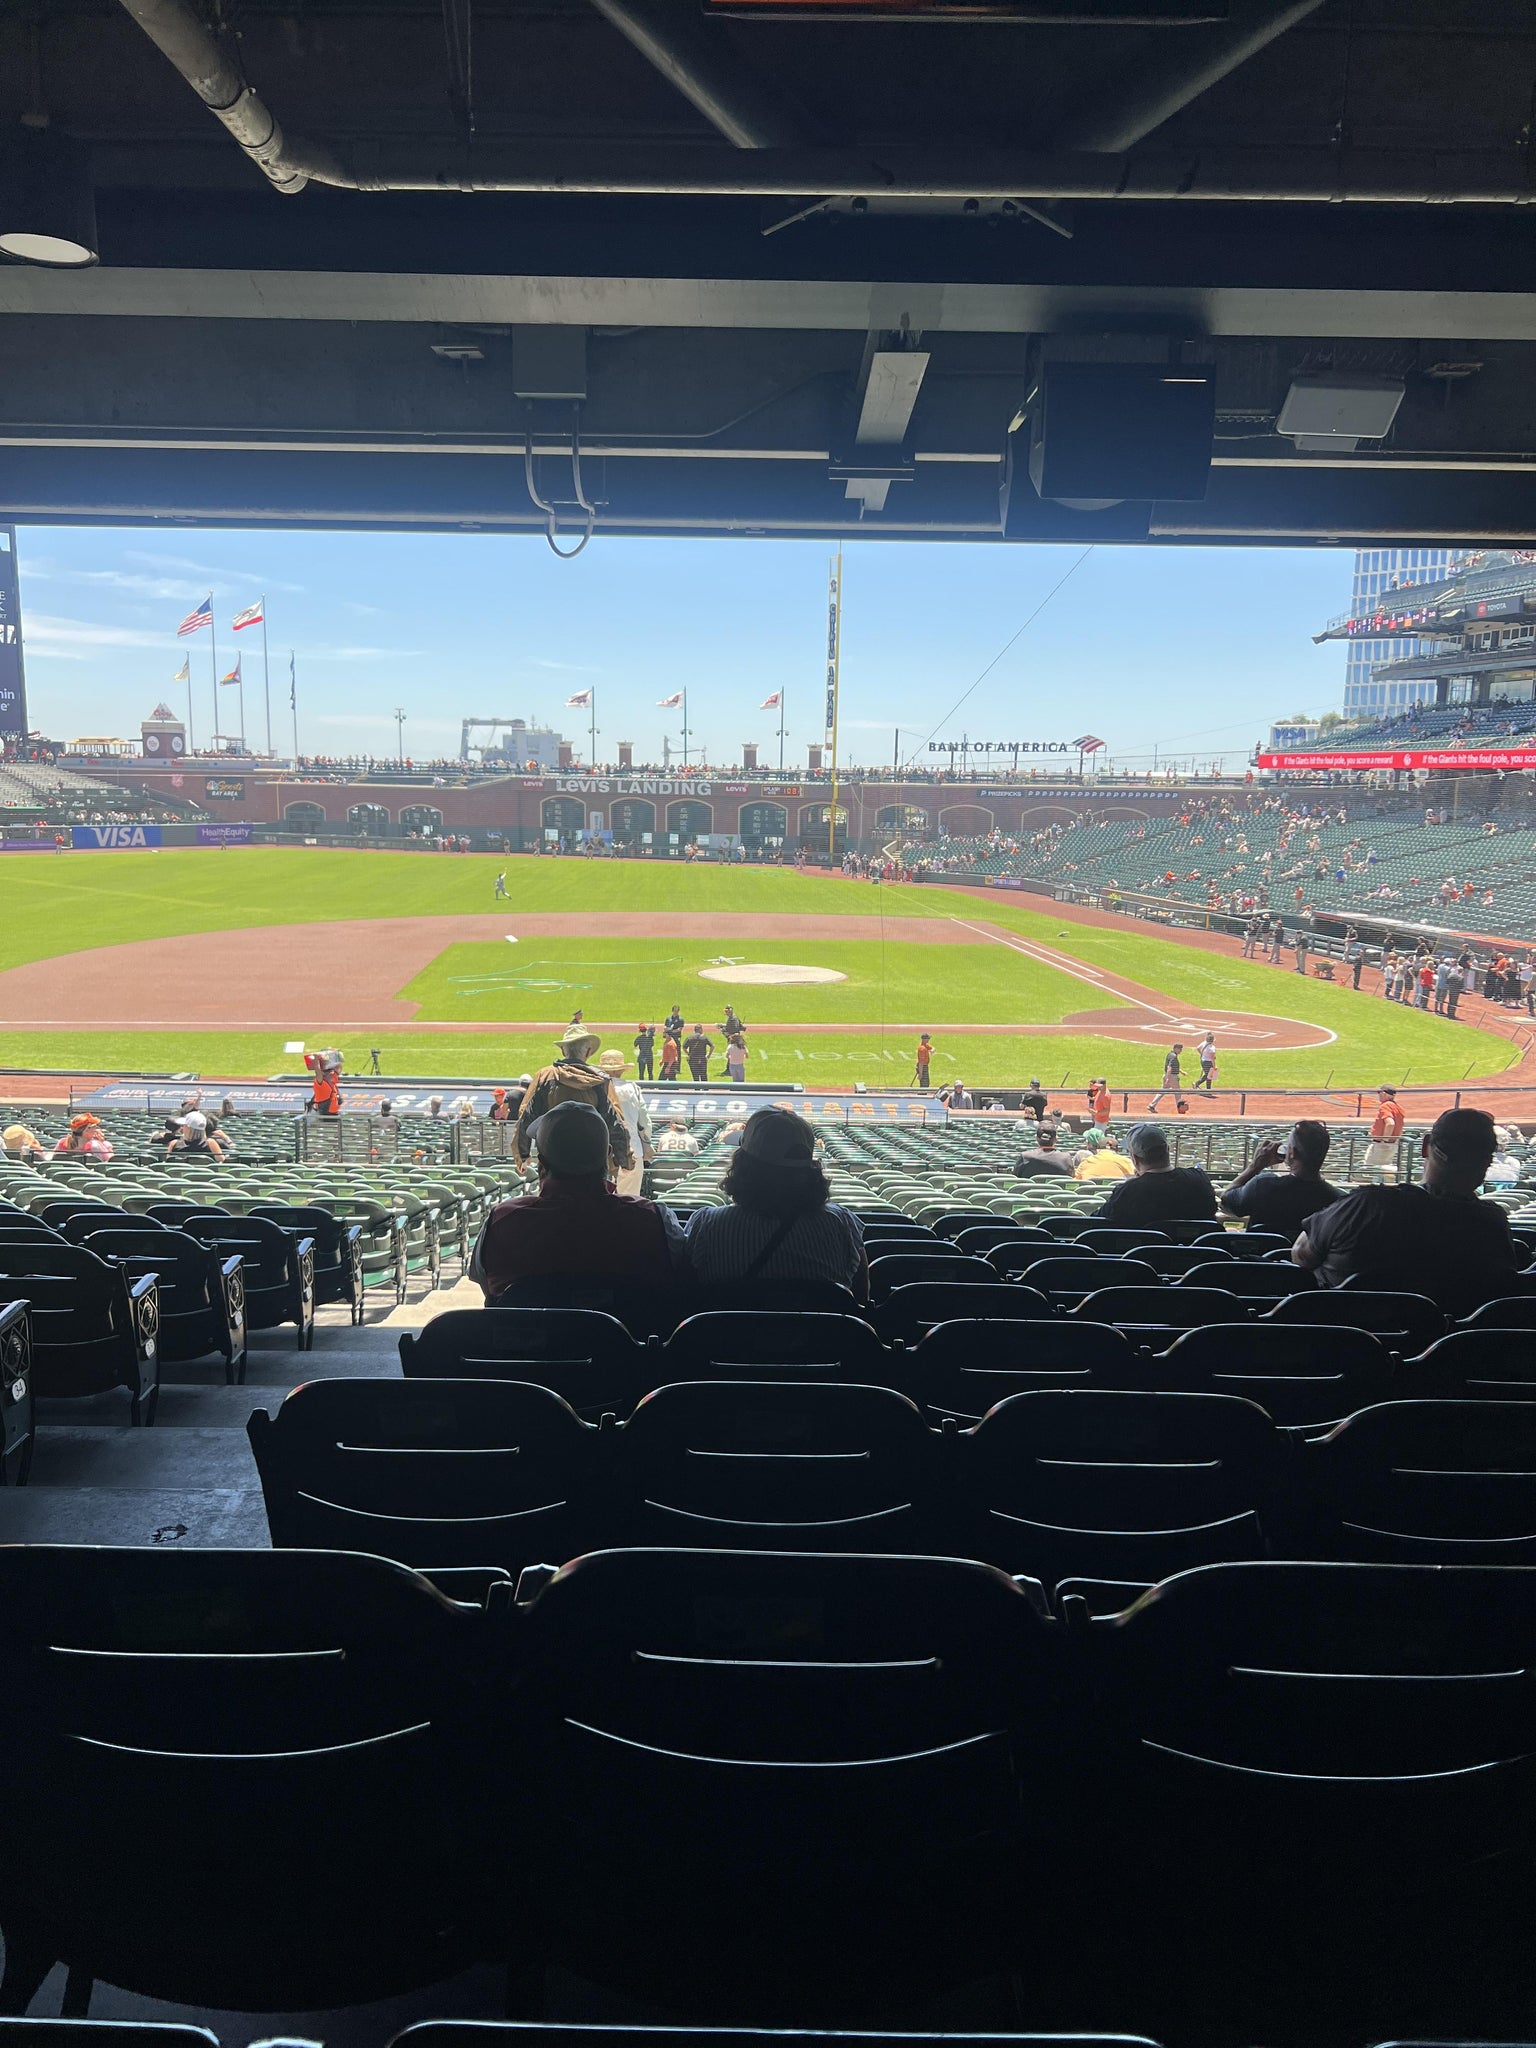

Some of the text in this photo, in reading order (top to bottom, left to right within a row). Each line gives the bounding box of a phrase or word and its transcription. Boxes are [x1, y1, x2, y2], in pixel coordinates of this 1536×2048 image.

[1487, 602, 1507, 612] TOYOTA
[928, 742, 1068, 752] BANK OF AMERICA
[1428, 755, 1438, 763] the
[1439, 754, 1457, 764] Giants
[1458, 754, 1467, 763] hit
[1468, 754, 1478, 763] the
[1479, 753, 1492, 763] foul
[1510, 756, 1523, 765] you
[617, 780, 712, 795] LANDING
[91, 827, 146, 847] VISA
[668, 1139, 686, 1150] 28
